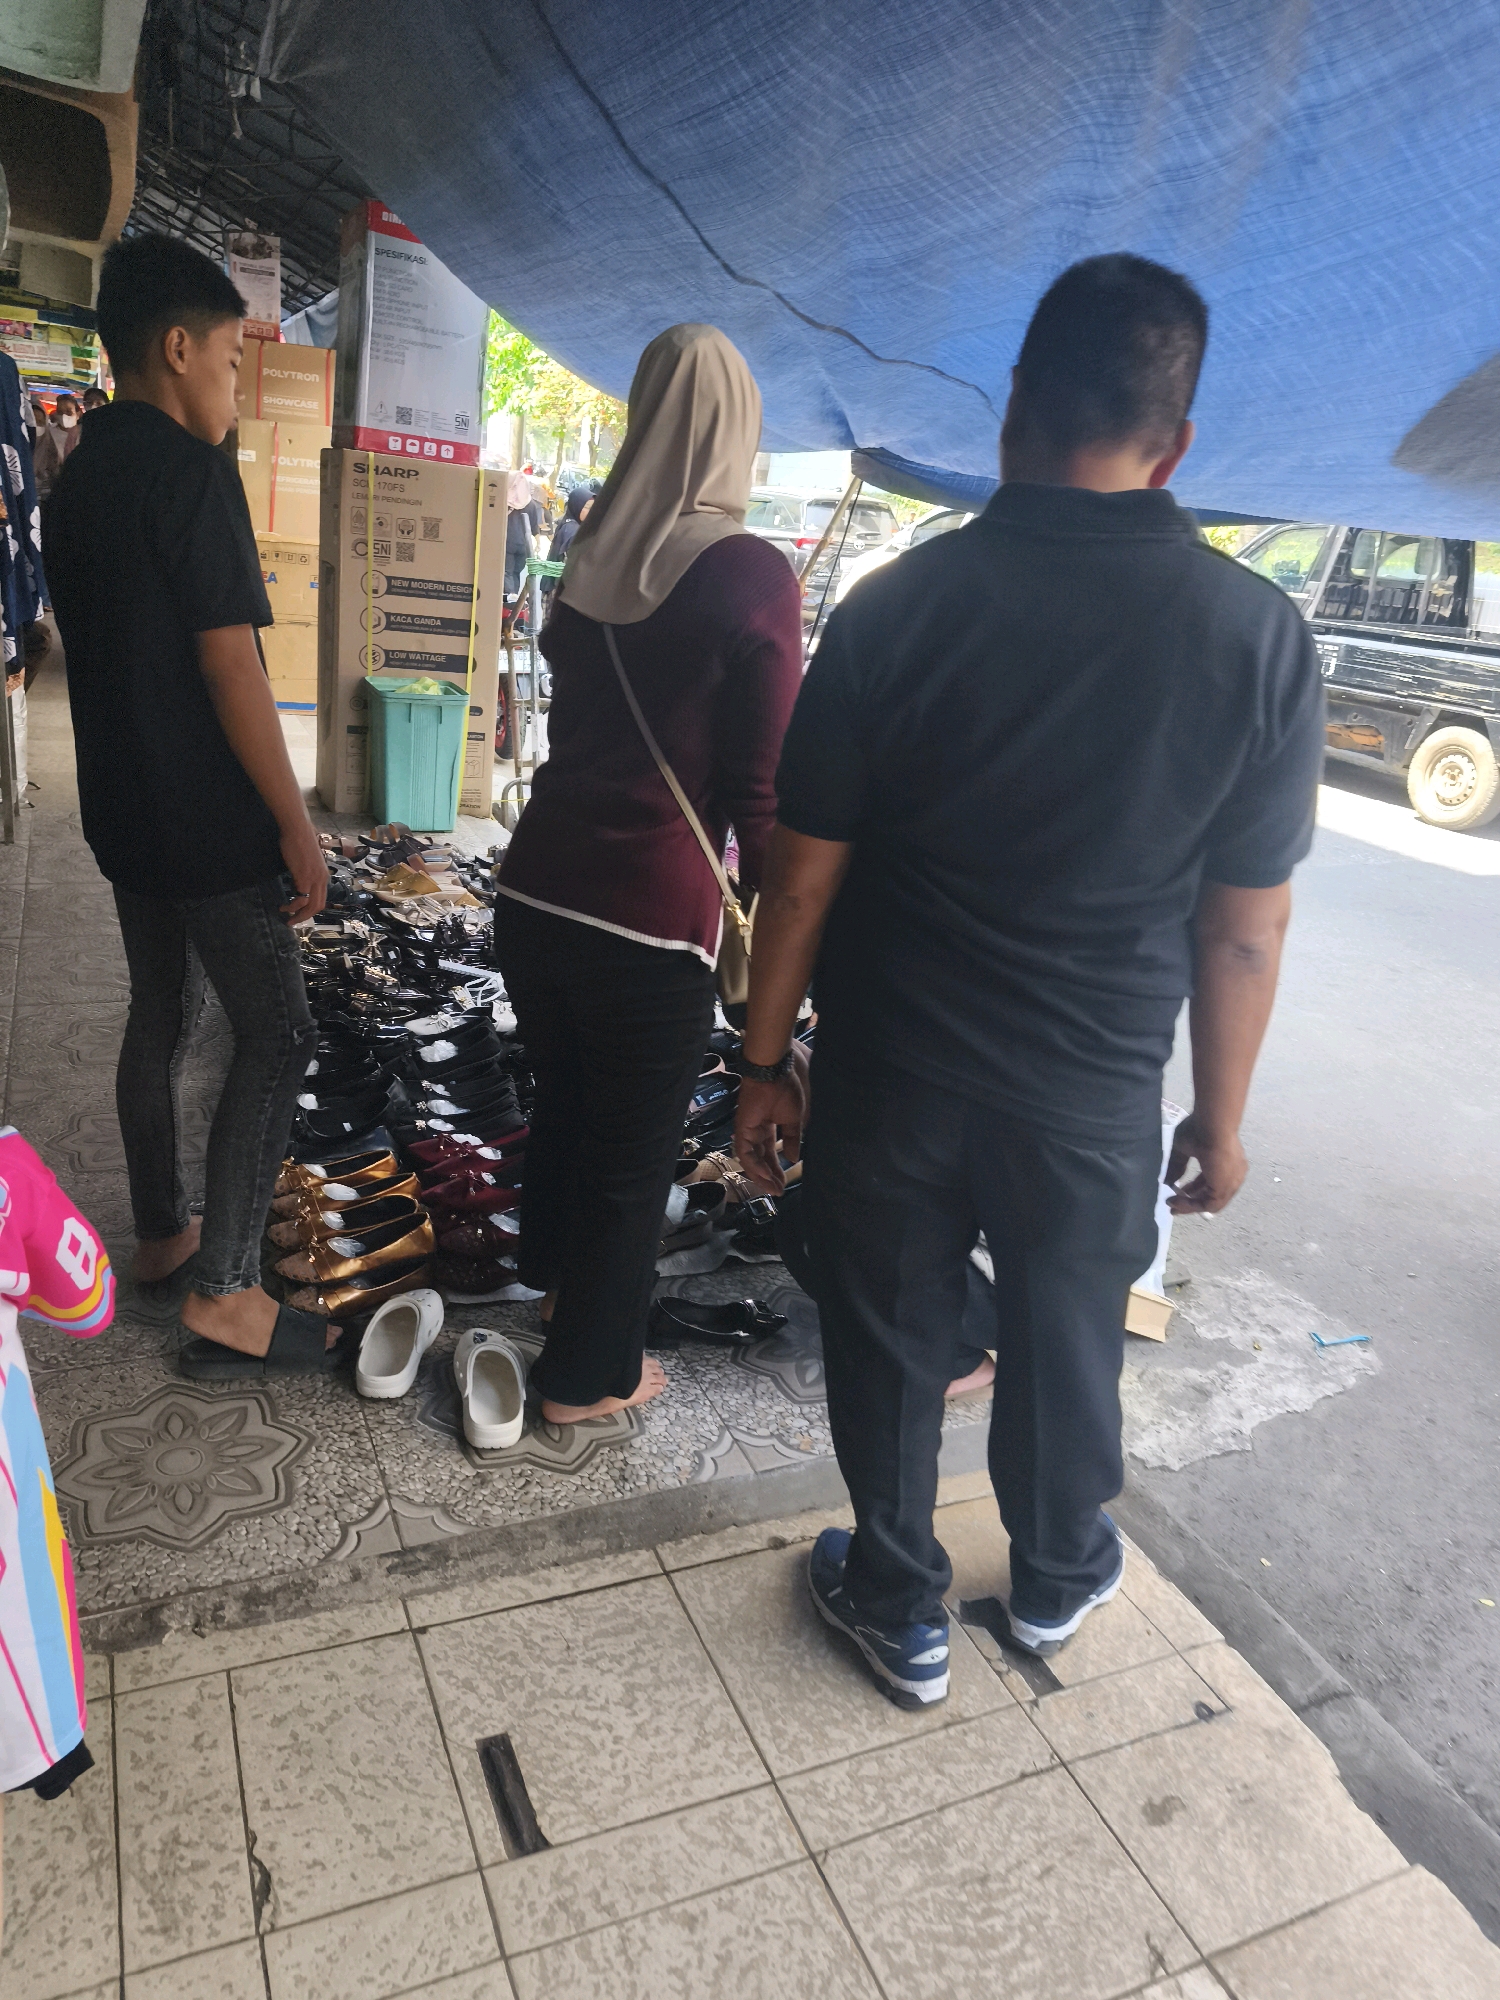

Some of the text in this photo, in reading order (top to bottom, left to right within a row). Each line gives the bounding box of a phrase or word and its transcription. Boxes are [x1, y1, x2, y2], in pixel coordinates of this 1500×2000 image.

[262, 396, 319, 410] SHOWCASE
[455, 416, 470, 429] SNI
[353, 462, 420, 480] SHARP
[352, 478, 405, 493] SC-170FS
[381, 496, 423, 507] PENDINGIN
[373, 542, 391, 556] SNI
[391, 579, 409, 588] NEW
[411, 581, 445, 591] MODERN
[390, 615, 441, 626] KACA GANDA
[389, 650, 447, 663] LOW WATTAGE
